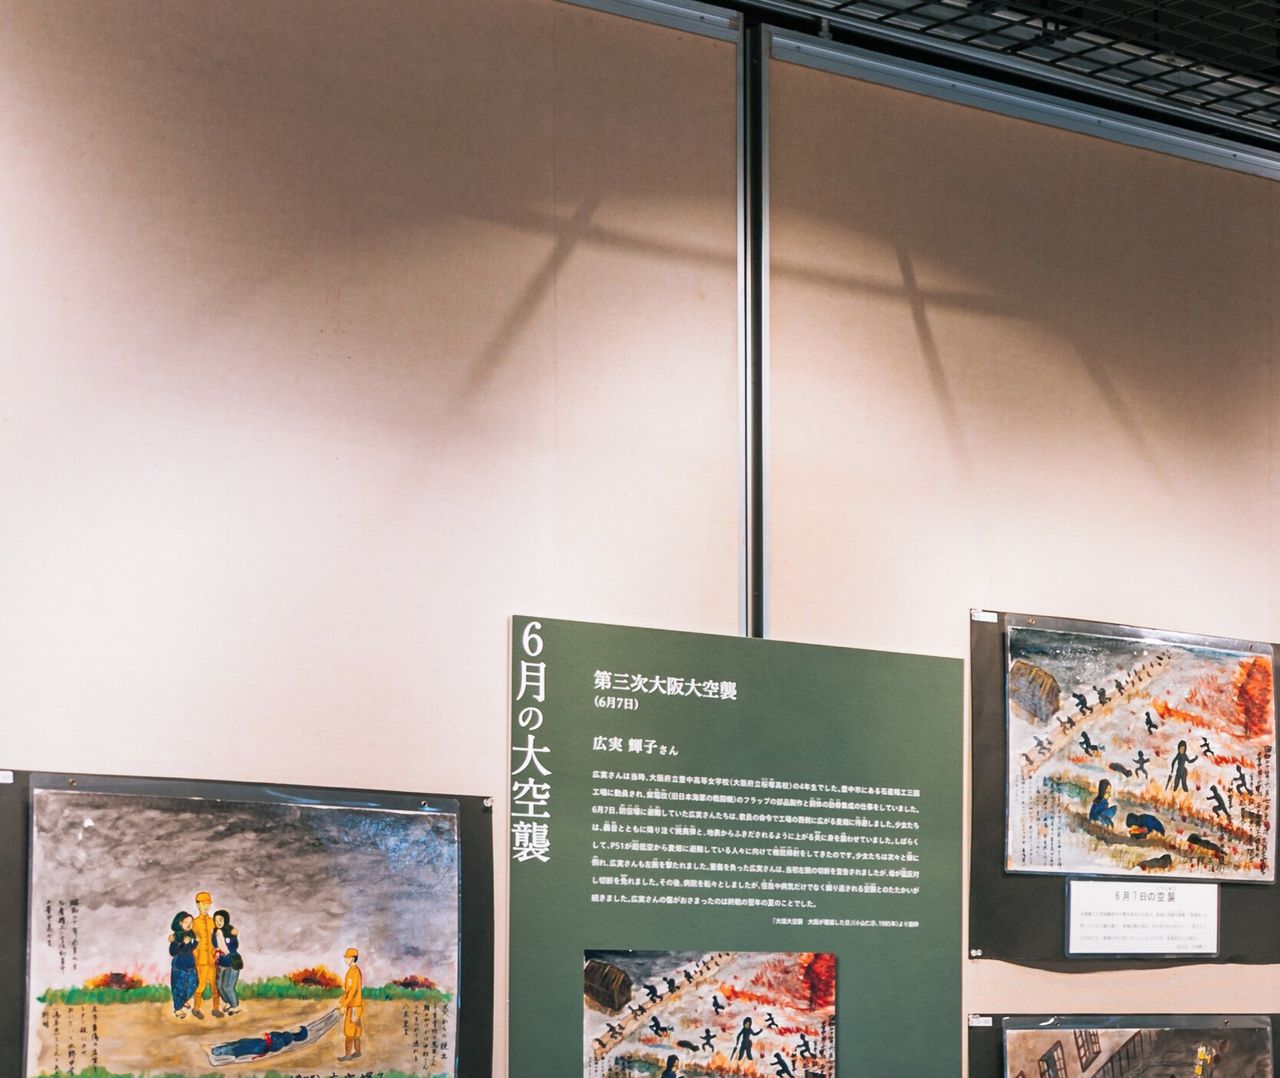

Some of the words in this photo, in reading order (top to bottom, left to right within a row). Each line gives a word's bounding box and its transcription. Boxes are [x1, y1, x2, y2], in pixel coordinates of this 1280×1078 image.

[594, 670, 737, 700] 第三次大阪大空襲
[594, 697, 639, 711] (6月7日)
[511, 621, 551, 862] 6月の大空襲
[592, 737, 623, 753] 広実
